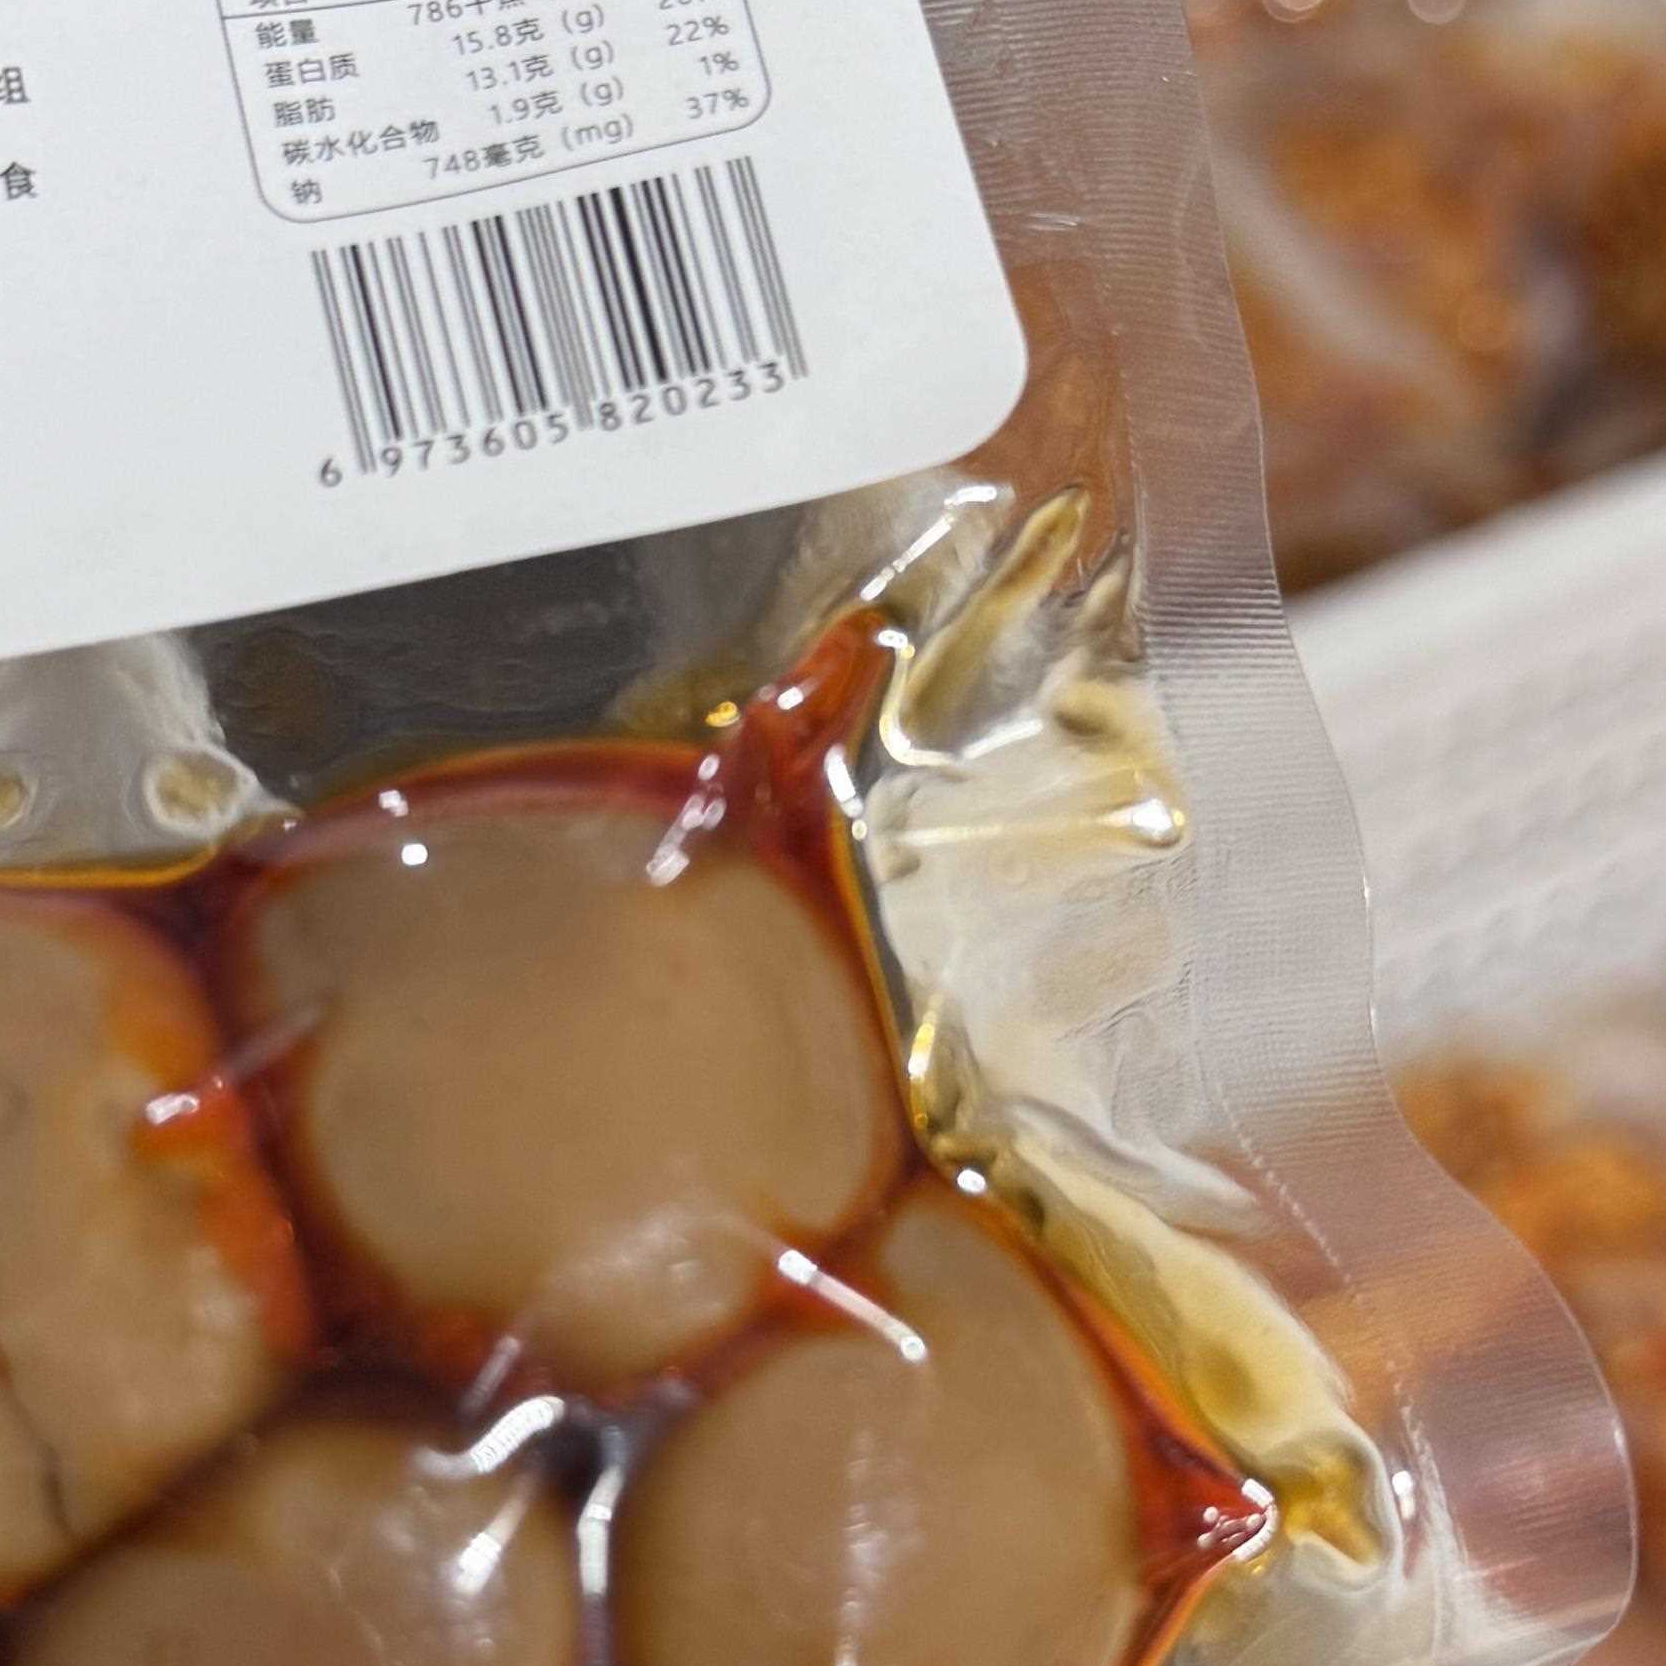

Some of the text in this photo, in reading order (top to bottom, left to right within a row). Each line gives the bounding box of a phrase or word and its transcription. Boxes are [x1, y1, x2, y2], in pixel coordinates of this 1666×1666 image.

[255, 20, 320, 50] 能量
[265, 52, 361, 89] 蛋白质
[273, 96, 337, 127] 脂肪
[667, 15, 731, 47] 22%
[281, 119, 441, 166] 碳水化合物
[701, 51, 740, 75] 1%
[290, 179, 323, 206] 钠
[687, 89, 751, 119] 37%
[318, 360, 786, 488] 6 973605 820233
